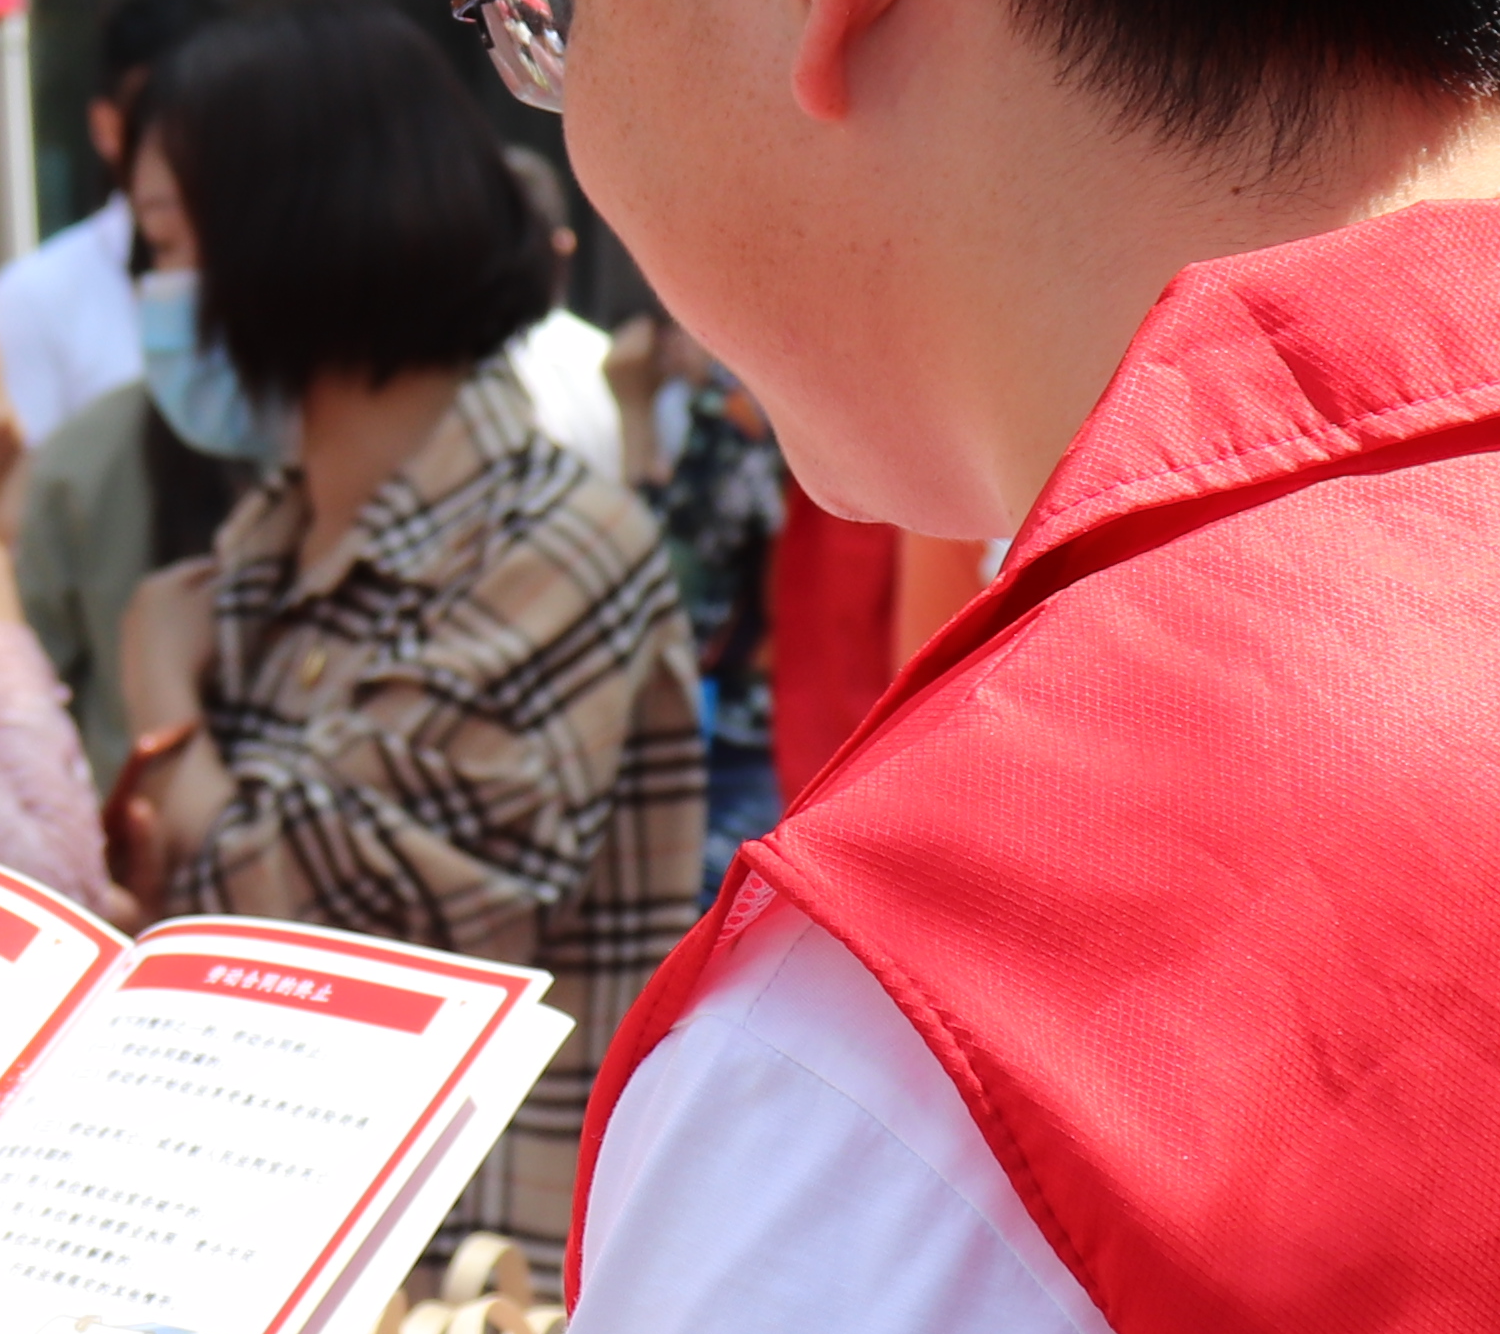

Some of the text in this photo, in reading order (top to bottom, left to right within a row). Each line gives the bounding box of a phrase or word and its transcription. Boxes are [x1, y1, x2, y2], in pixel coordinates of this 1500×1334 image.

[203, 964, 334, 1003] 劳动合同的终止
